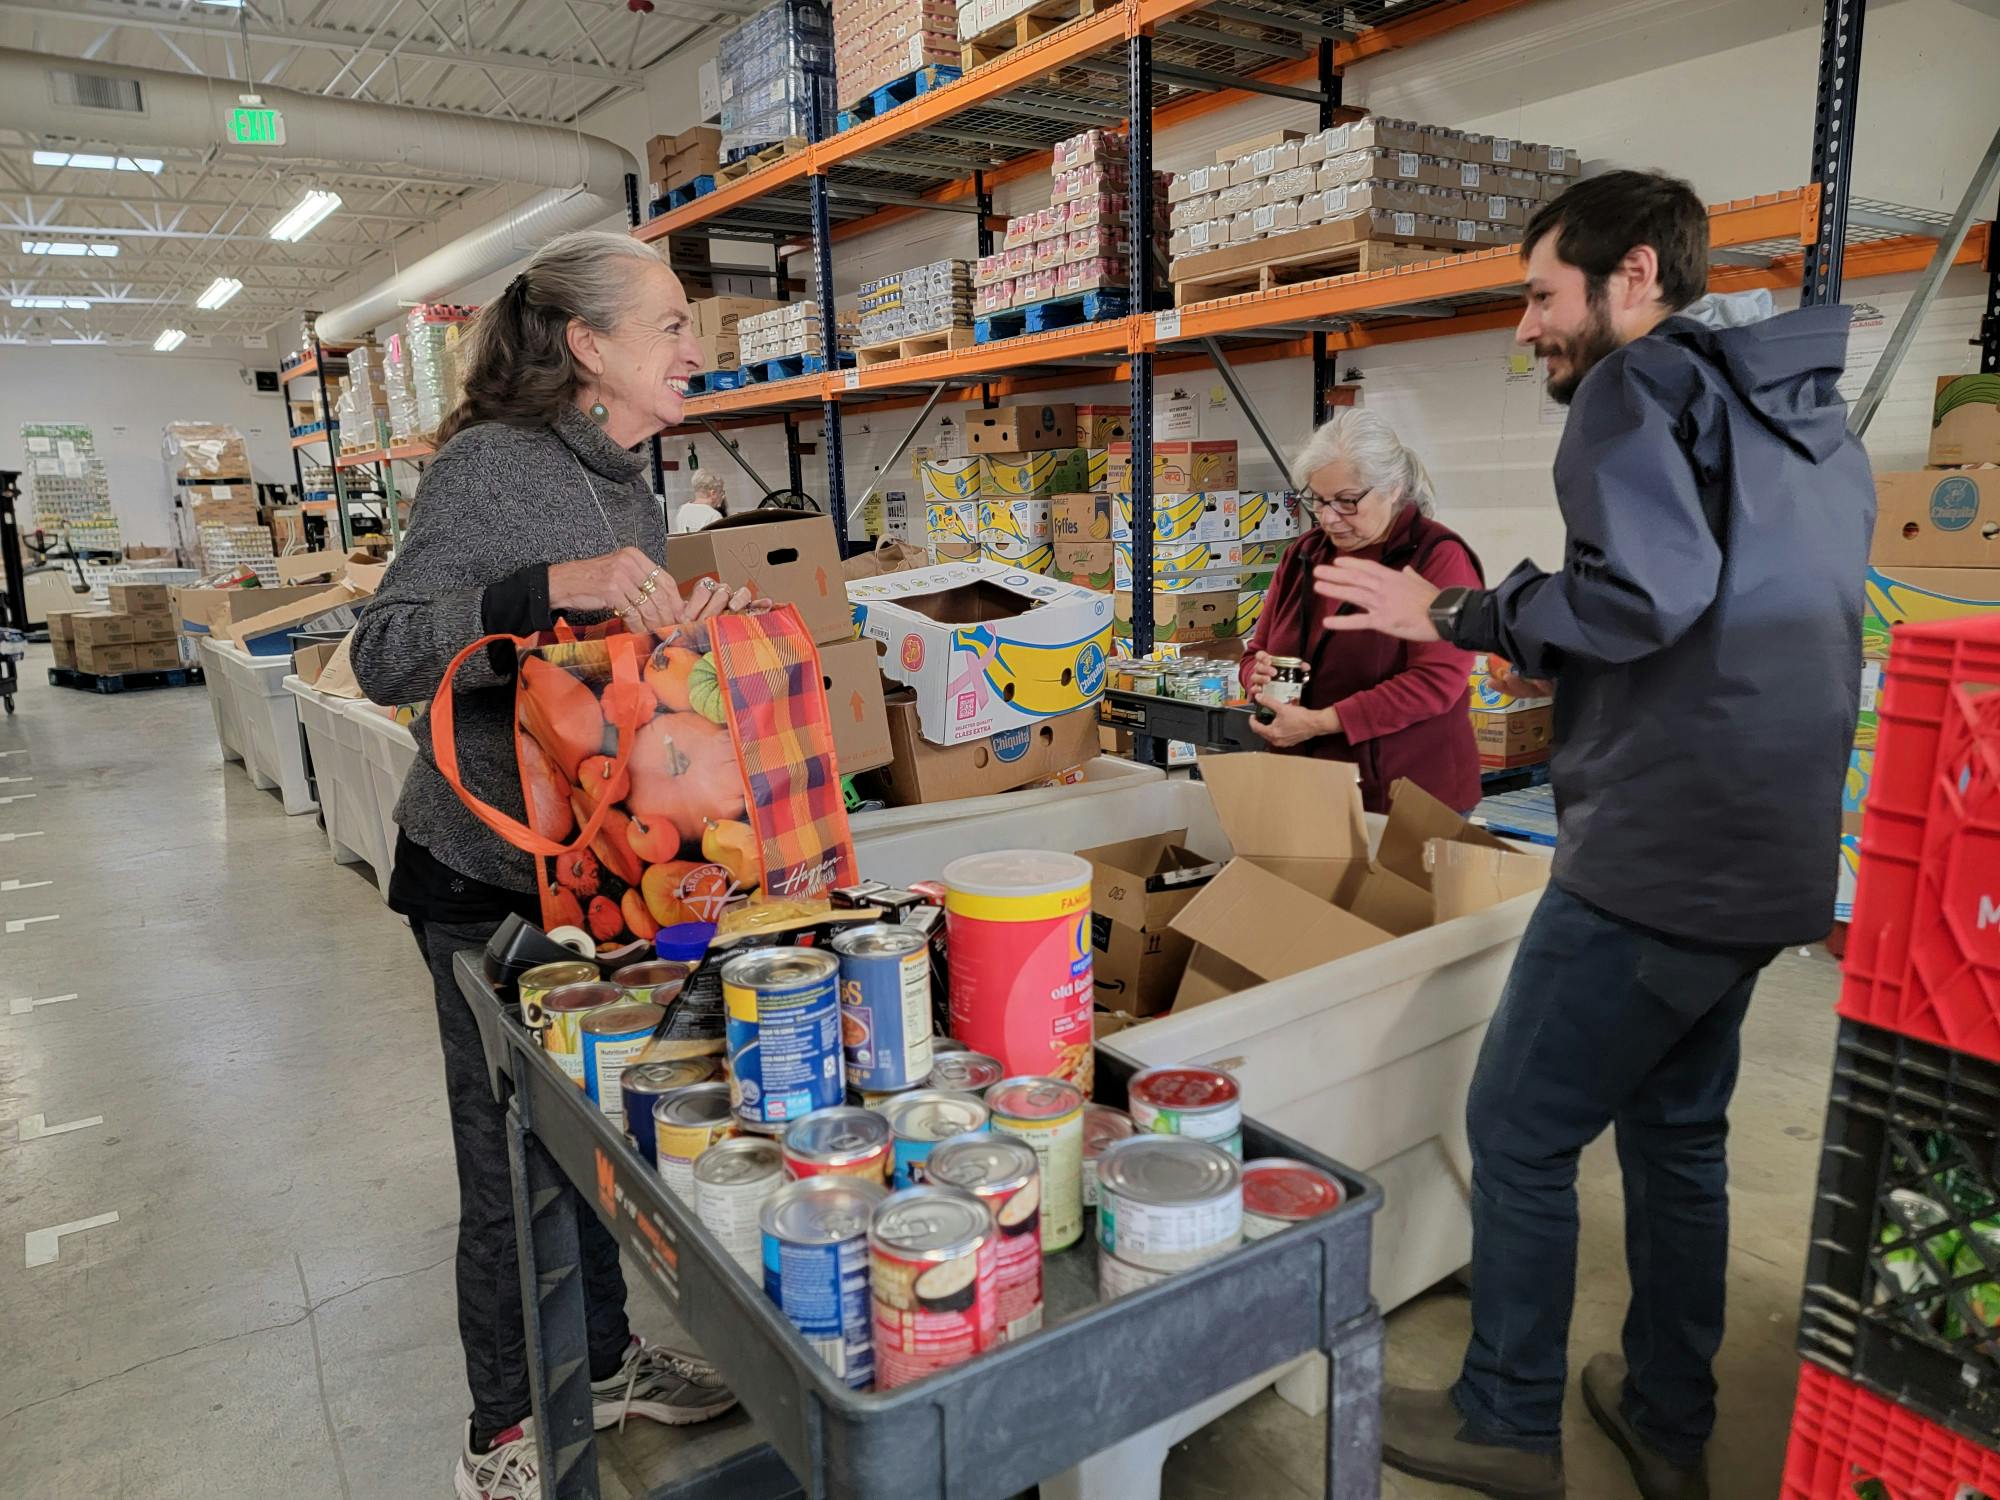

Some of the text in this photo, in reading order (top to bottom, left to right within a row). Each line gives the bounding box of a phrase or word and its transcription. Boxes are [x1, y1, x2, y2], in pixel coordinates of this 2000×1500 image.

[233, 109, 275, 142] EXIT
[1054, 517, 1078, 537] fyffes
[1079, 660, 1106, 692] Chiquita
[955, 725, 991, 739] CLASS EXTRA
[992, 731, 1030, 752] Chiquita
[685, 866, 729, 892] HAGGEN
[772, 856, 844, 894] Haggen
[1051, 982, 1073, 1001] old
